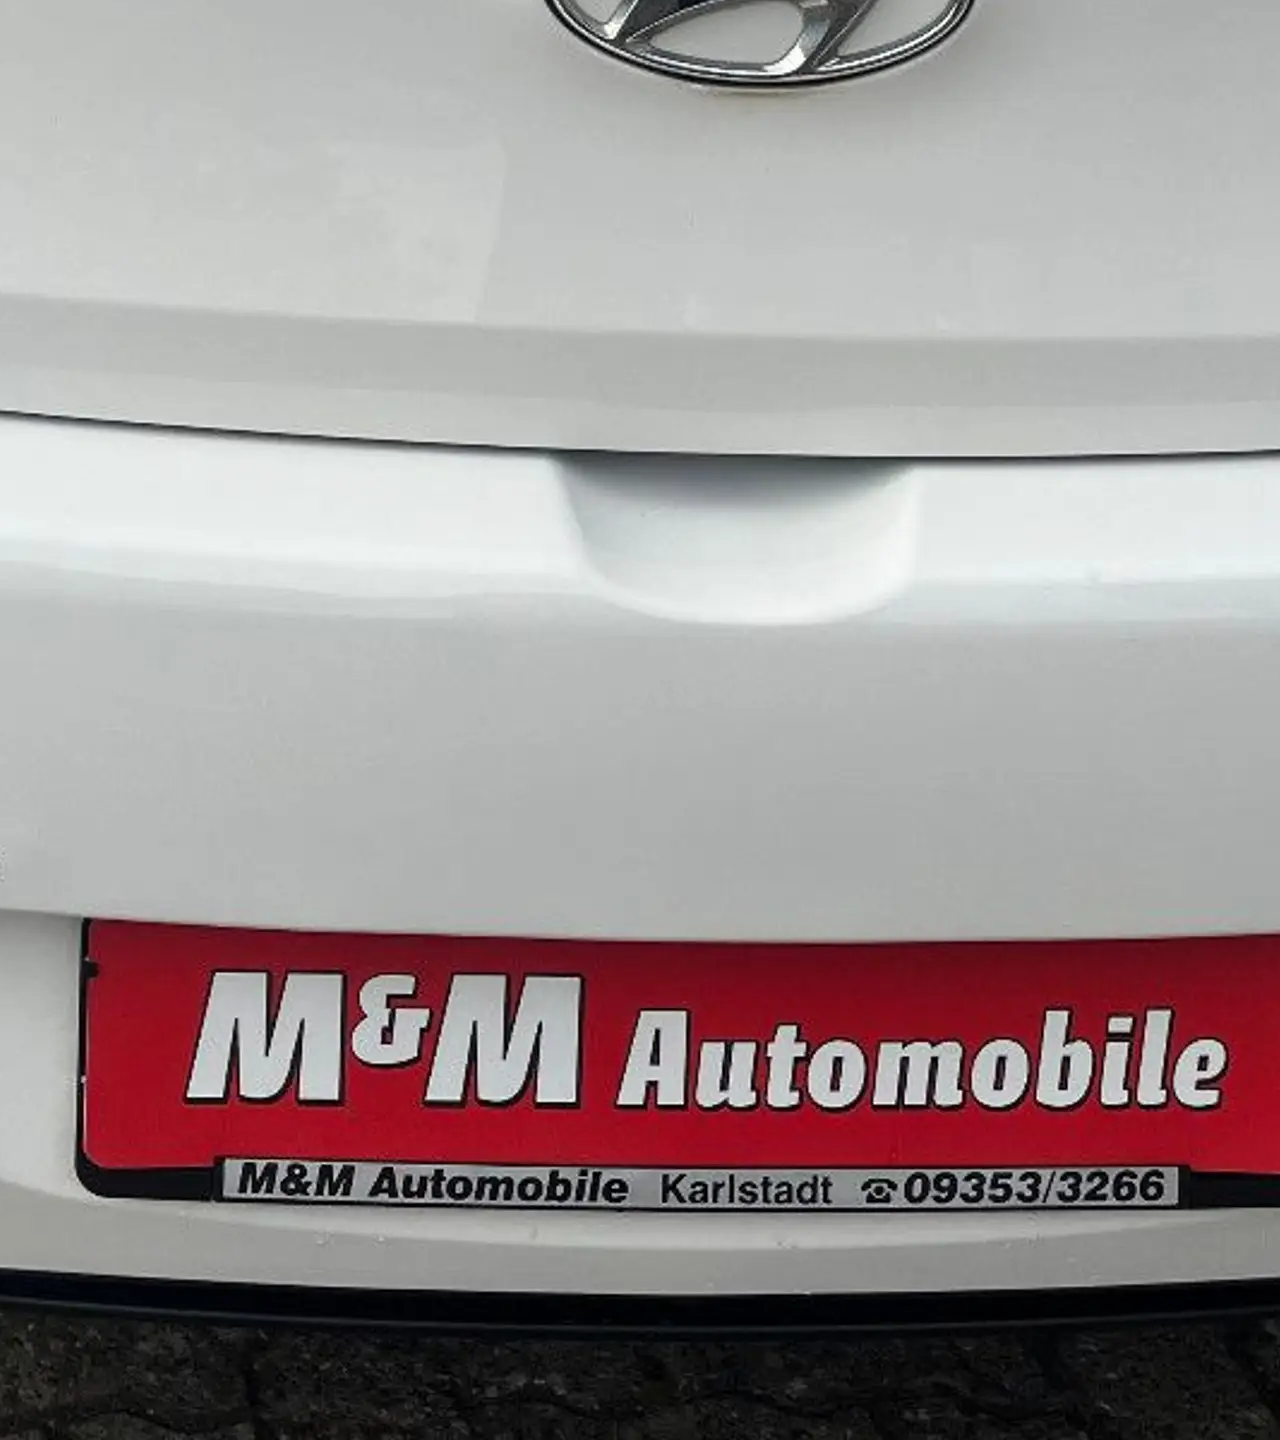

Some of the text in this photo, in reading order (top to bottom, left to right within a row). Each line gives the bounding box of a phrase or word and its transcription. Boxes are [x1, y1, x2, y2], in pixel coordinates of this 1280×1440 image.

[184, 969, 1229, 1111] M&M Automobile
[237, 1162, 1166, 1206] M&M Automobile Karlstadt 09353/3266
